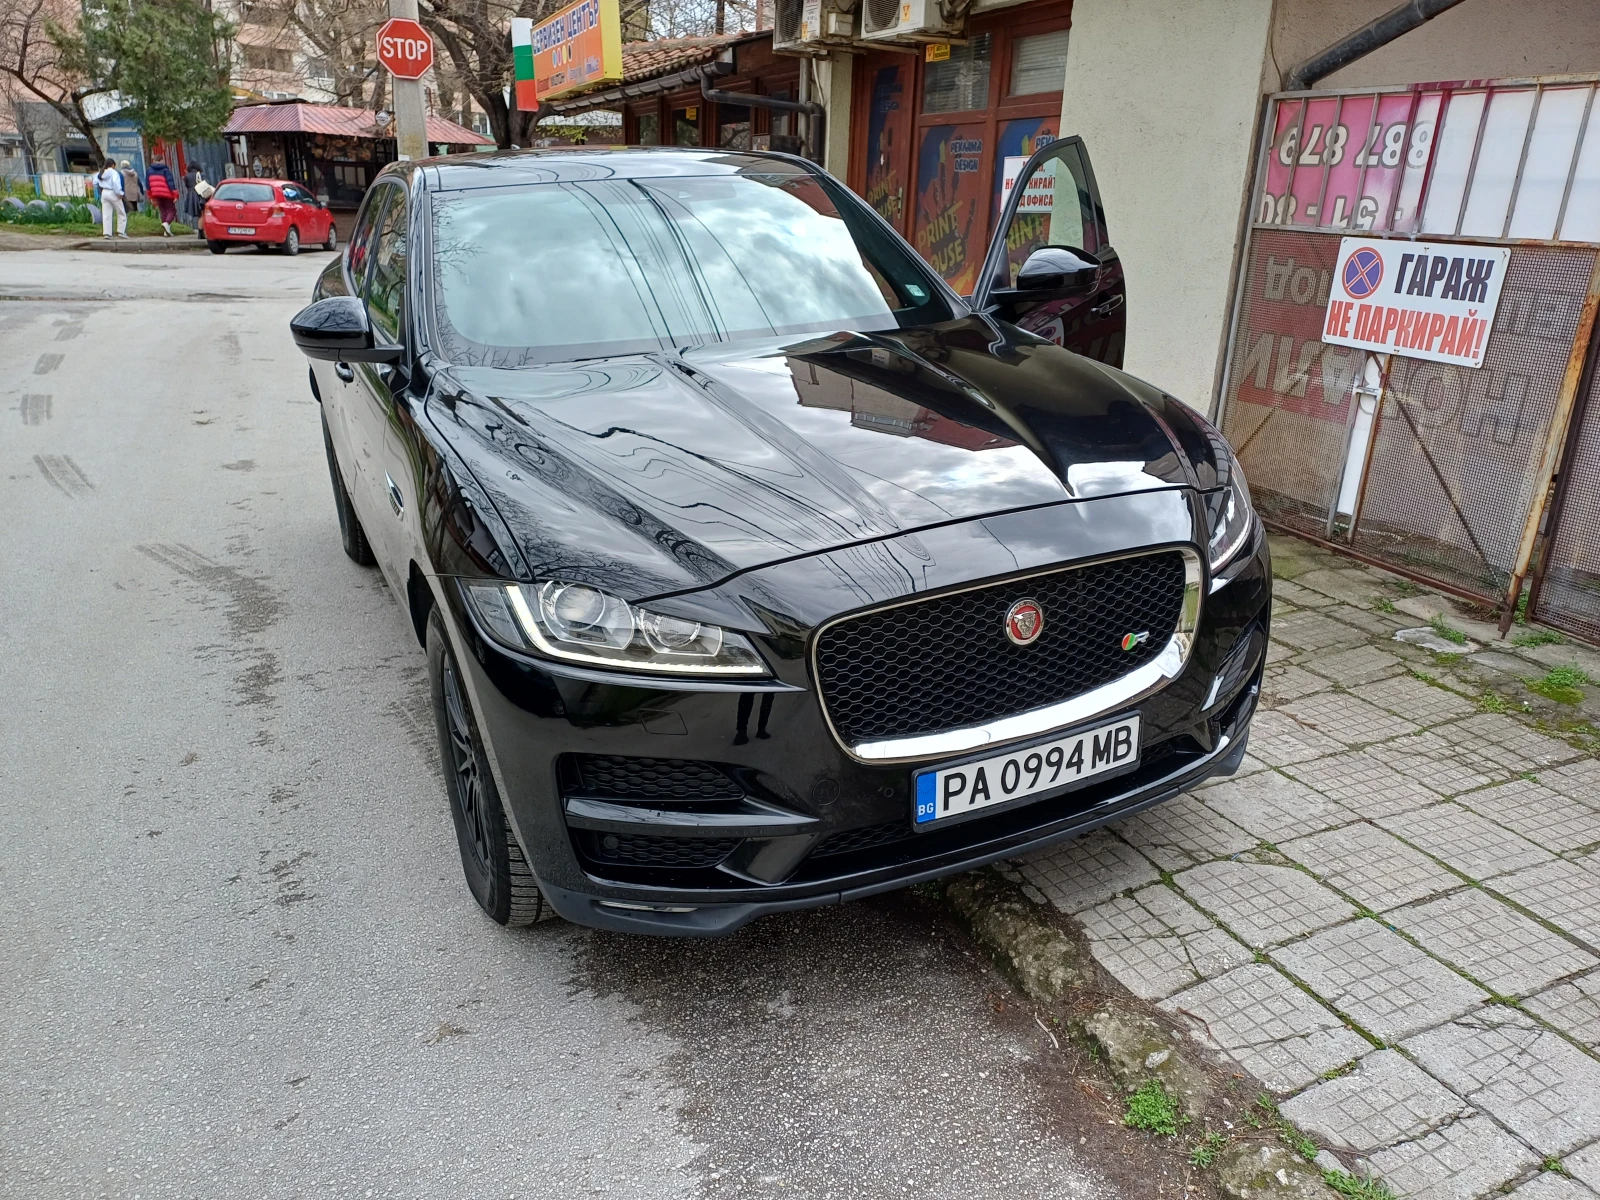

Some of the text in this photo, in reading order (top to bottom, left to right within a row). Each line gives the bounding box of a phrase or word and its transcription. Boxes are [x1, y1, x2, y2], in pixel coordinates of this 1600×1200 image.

[382, 36, 428, 61] STOP
[954, 157, 979, 172] DESIGN
[1027, 195, 1053, 206] ОФИСА
[917, 200, 963, 252] PRINT
[1007, 214, 1043, 253] RINT
[1394, 253, 1495, 303] ГАРАЖ
[1326, 300, 1351, 338] НЕ
[1353, 304, 1488, 360] ПАРКИРАЙ!
[943, 725, 1132, 811] PA 0994 MB
[918, 802, 934, 816] BG
